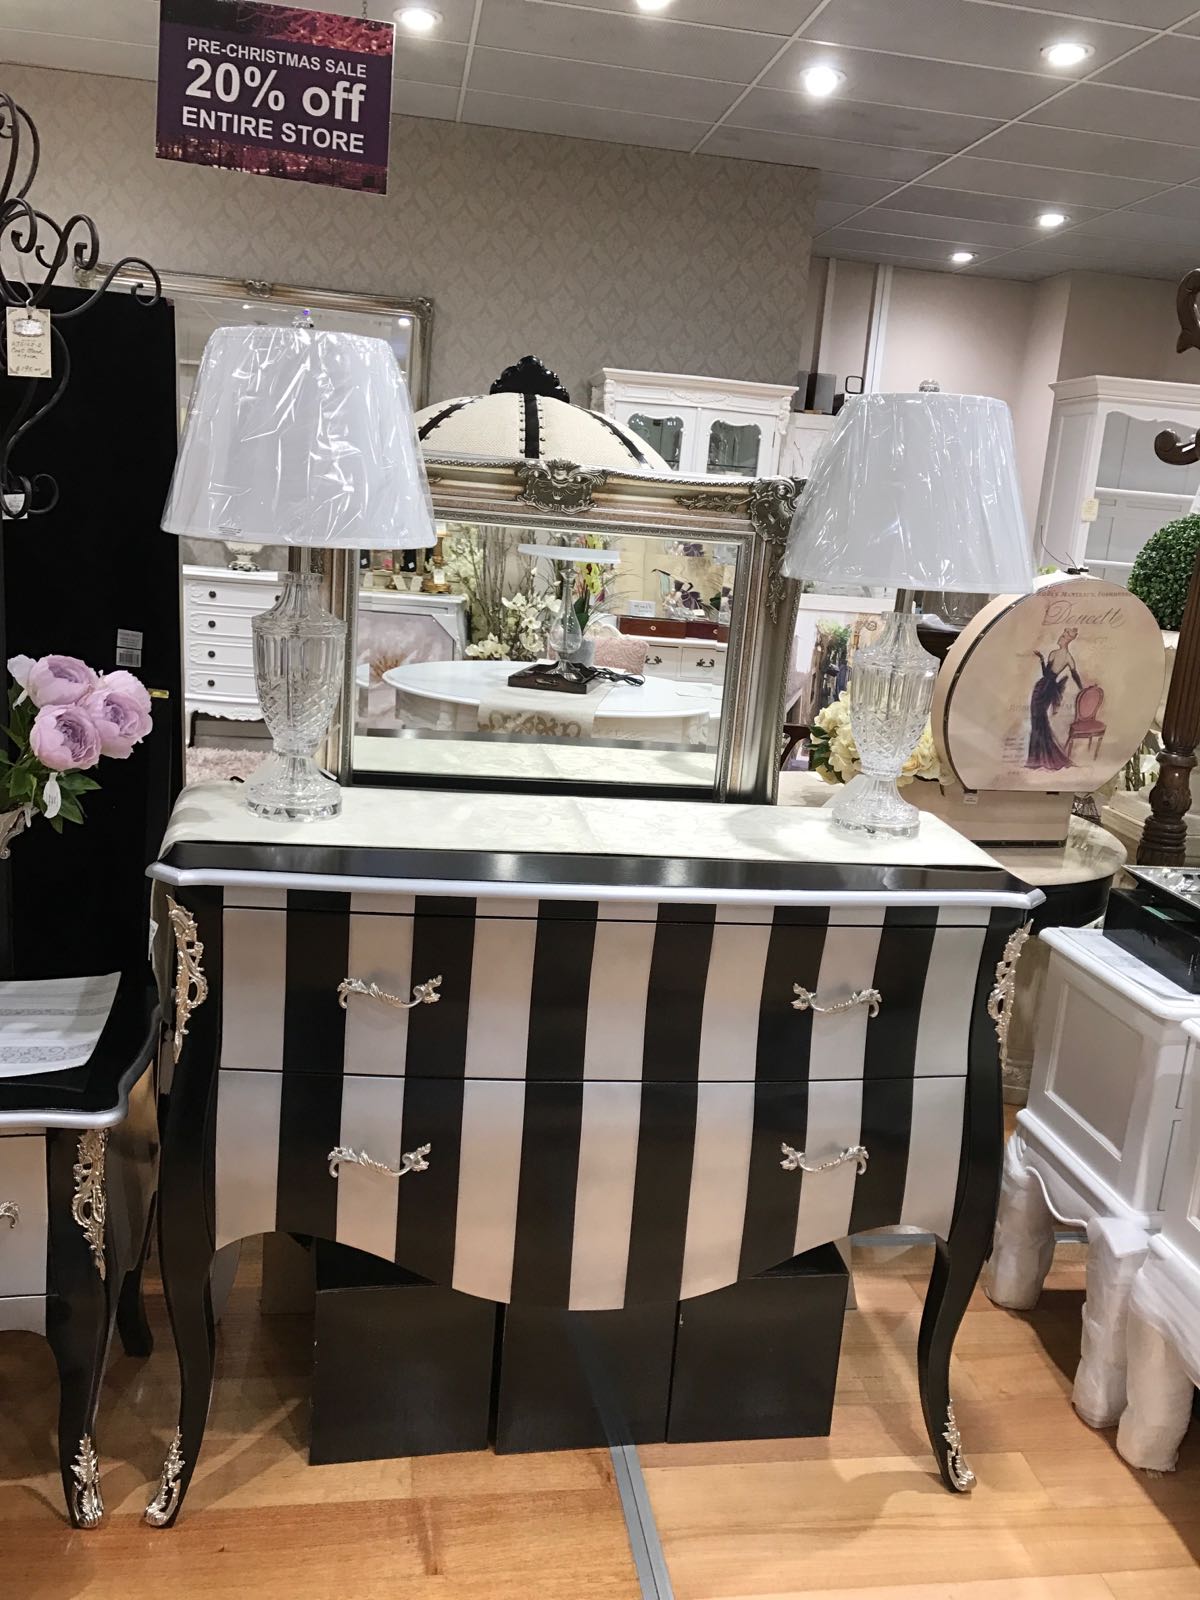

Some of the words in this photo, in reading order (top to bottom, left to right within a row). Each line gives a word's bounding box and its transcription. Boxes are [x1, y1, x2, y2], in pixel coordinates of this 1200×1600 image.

[187, 37, 321, 71] PRE-CHRISTMAS
[325, 59, 367, 78] SALE
[185, 57, 286, 112] 20%
[302, 80, 367, 123] off
[182, 106, 274, 140] ENTIRE
[281, 122, 365, 154] STORE
